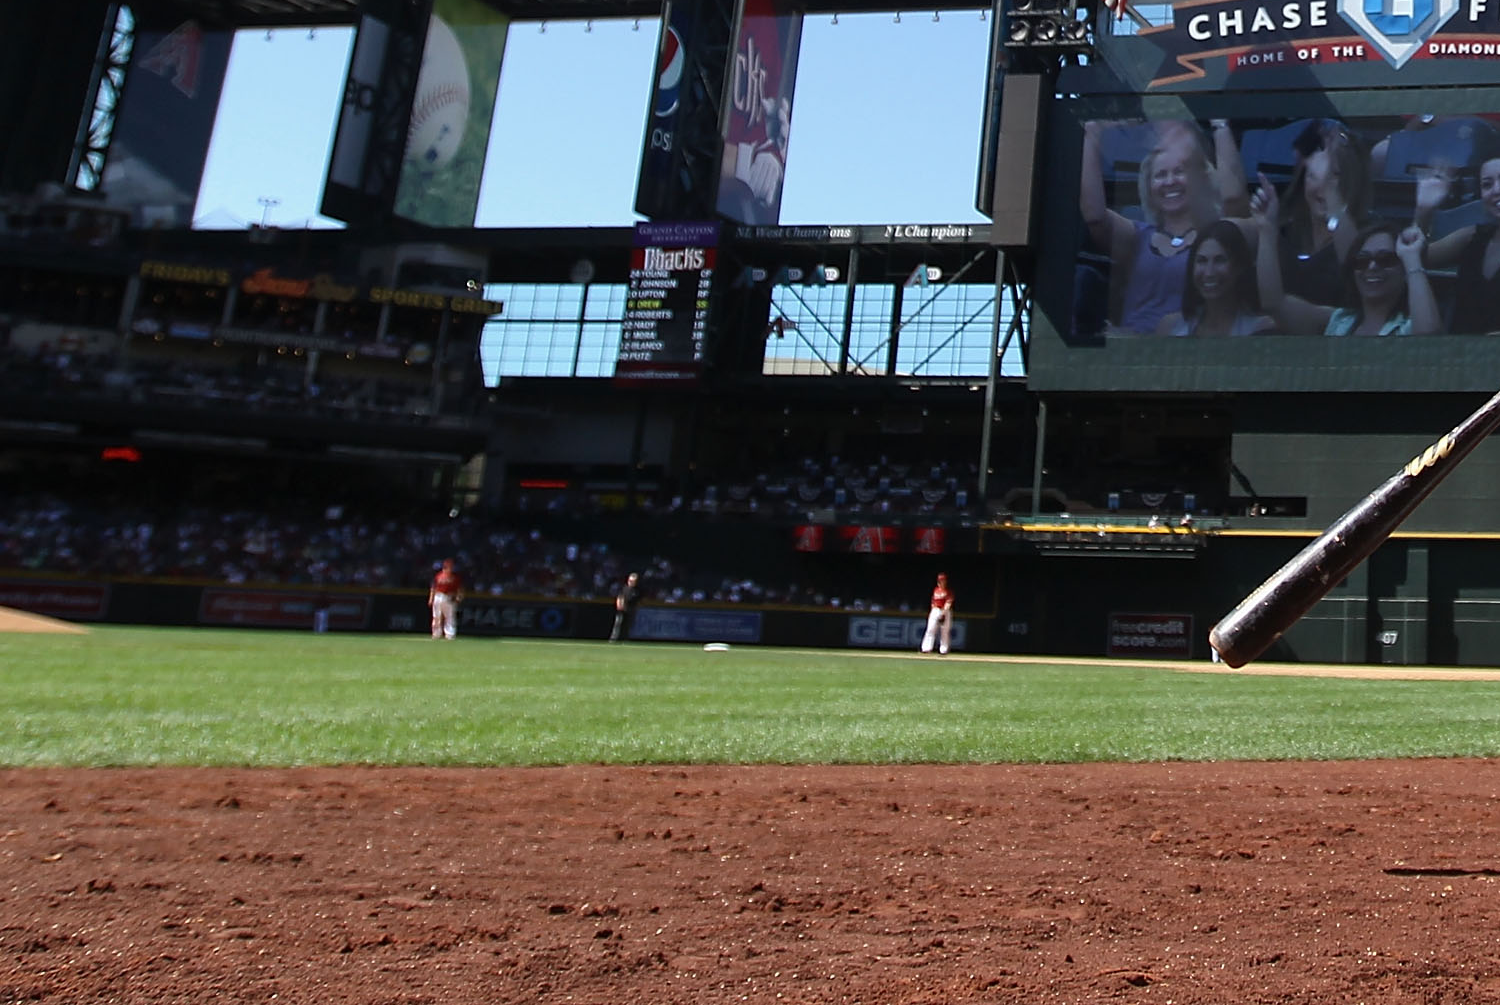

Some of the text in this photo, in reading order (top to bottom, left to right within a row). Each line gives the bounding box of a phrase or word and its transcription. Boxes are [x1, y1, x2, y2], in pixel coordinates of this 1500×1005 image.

[1188, 0, 1329, 41] CHASE
[1236, 51, 1285, 68] HOME
[1297, 46, 1320, 60] OF
[1331, 44, 1365, 59] THE
[638, 290, 667, 299] UPTON
[640, 279, 677, 289] JOHNSON
[456, 604, 535, 630] HASE
